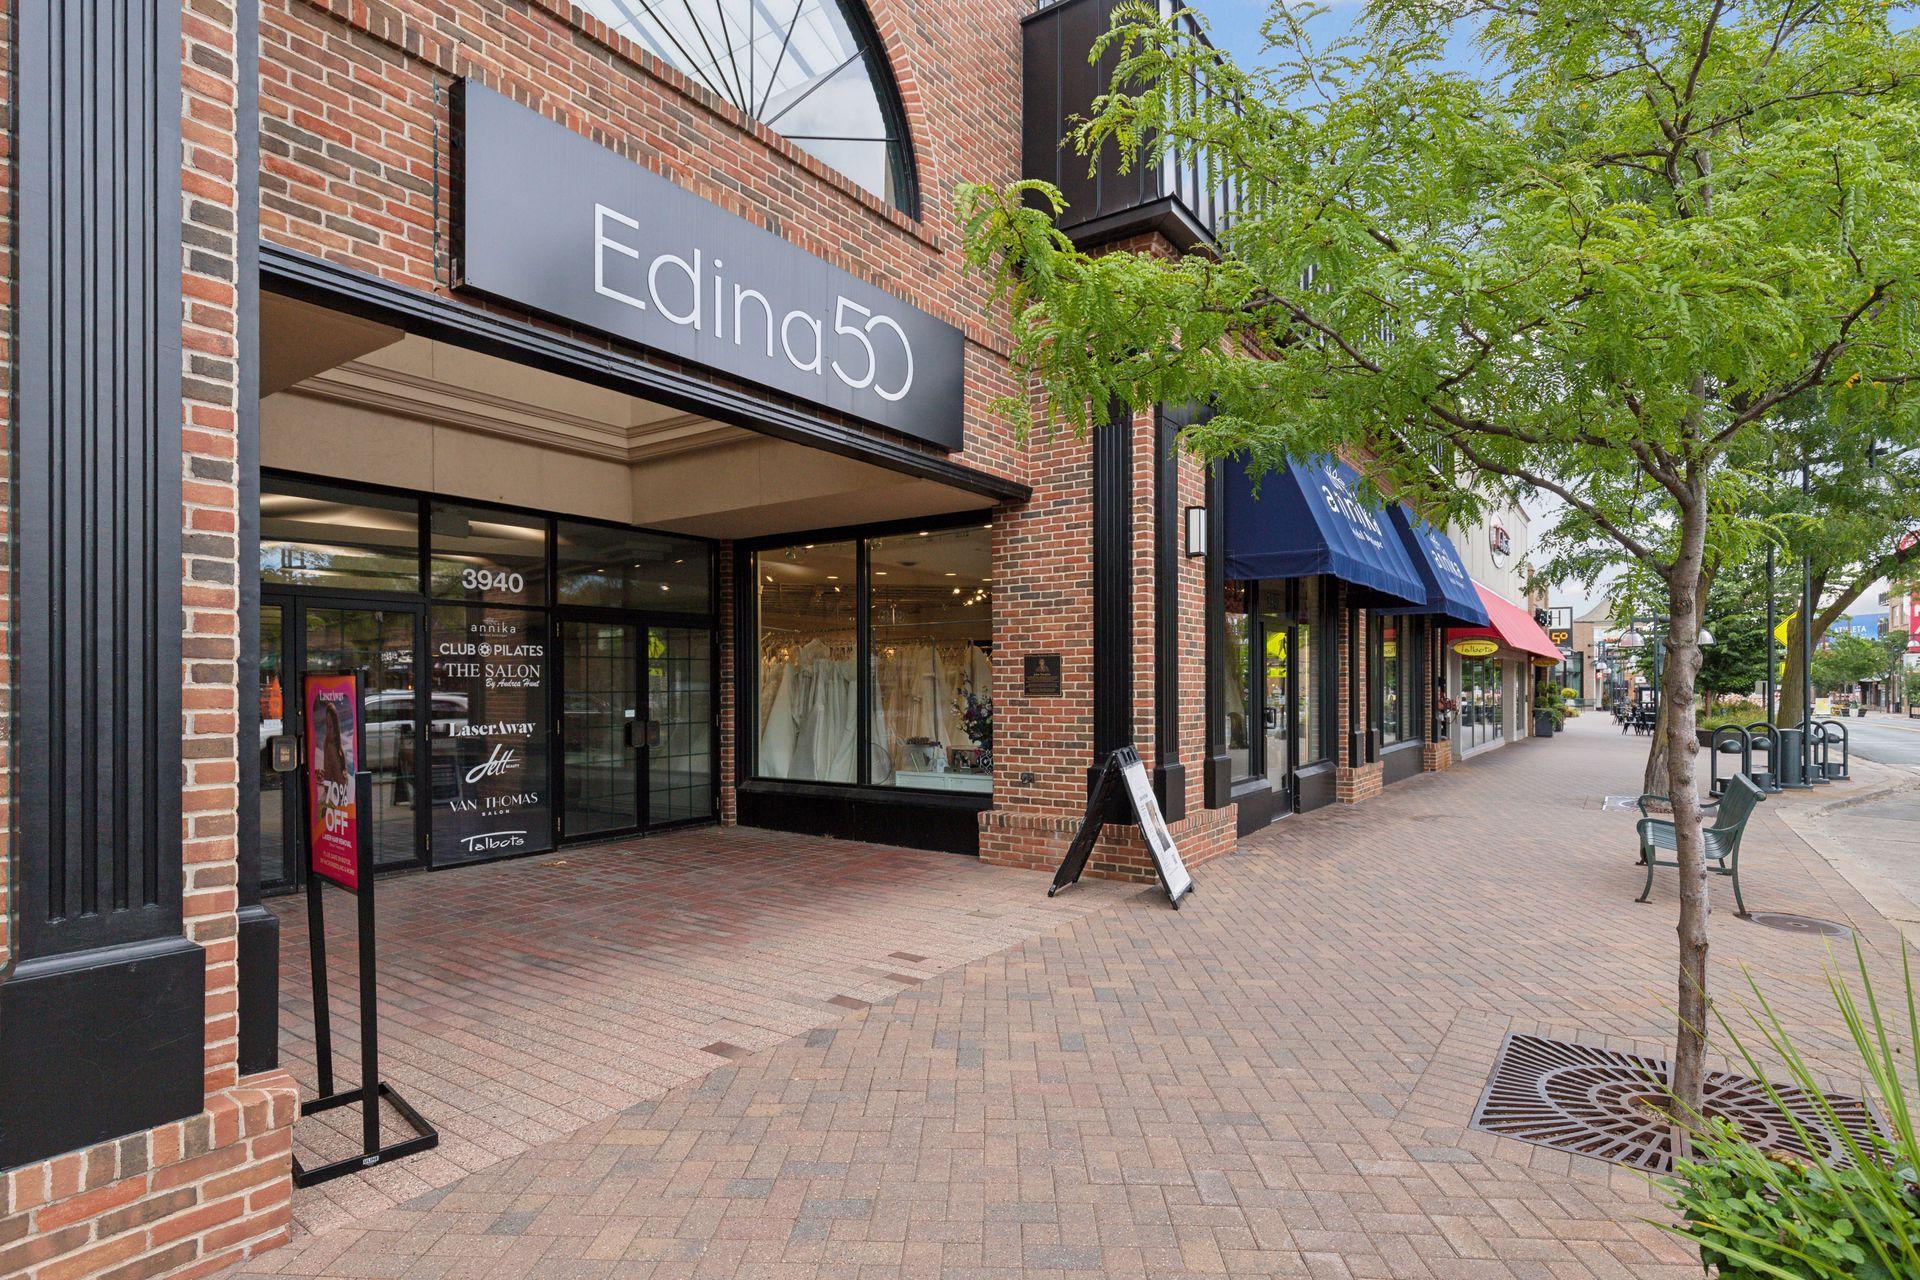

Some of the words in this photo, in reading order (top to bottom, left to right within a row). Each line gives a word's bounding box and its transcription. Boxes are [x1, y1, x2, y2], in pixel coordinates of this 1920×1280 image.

[462, 568, 524, 593] 3940
[470, 622, 516, 634] annika
[439, 643, 476, 655] CLUB
[493, 645, 544, 657] PILATES
[1457, 642, 1493, 653] Talbots
[444, 663, 480, 677] THE
[485, 664, 541, 678] SALON
[485, 678, 496, 689] By
[497, 678, 522, 688] Andrea
[522, 679, 540, 687] Hunt
[448, 721, 537, 738] LaserAway
[465, 743, 522, 783] Jett
[323, 780, 349, 807] 70%
[449, 799, 478, 812] VAN
[484, 792, 538, 809] THOMAS
[325, 807, 349, 835] OFF
[481, 809, 510, 817] SALON
[460, 831, 527, 852] Talbots
